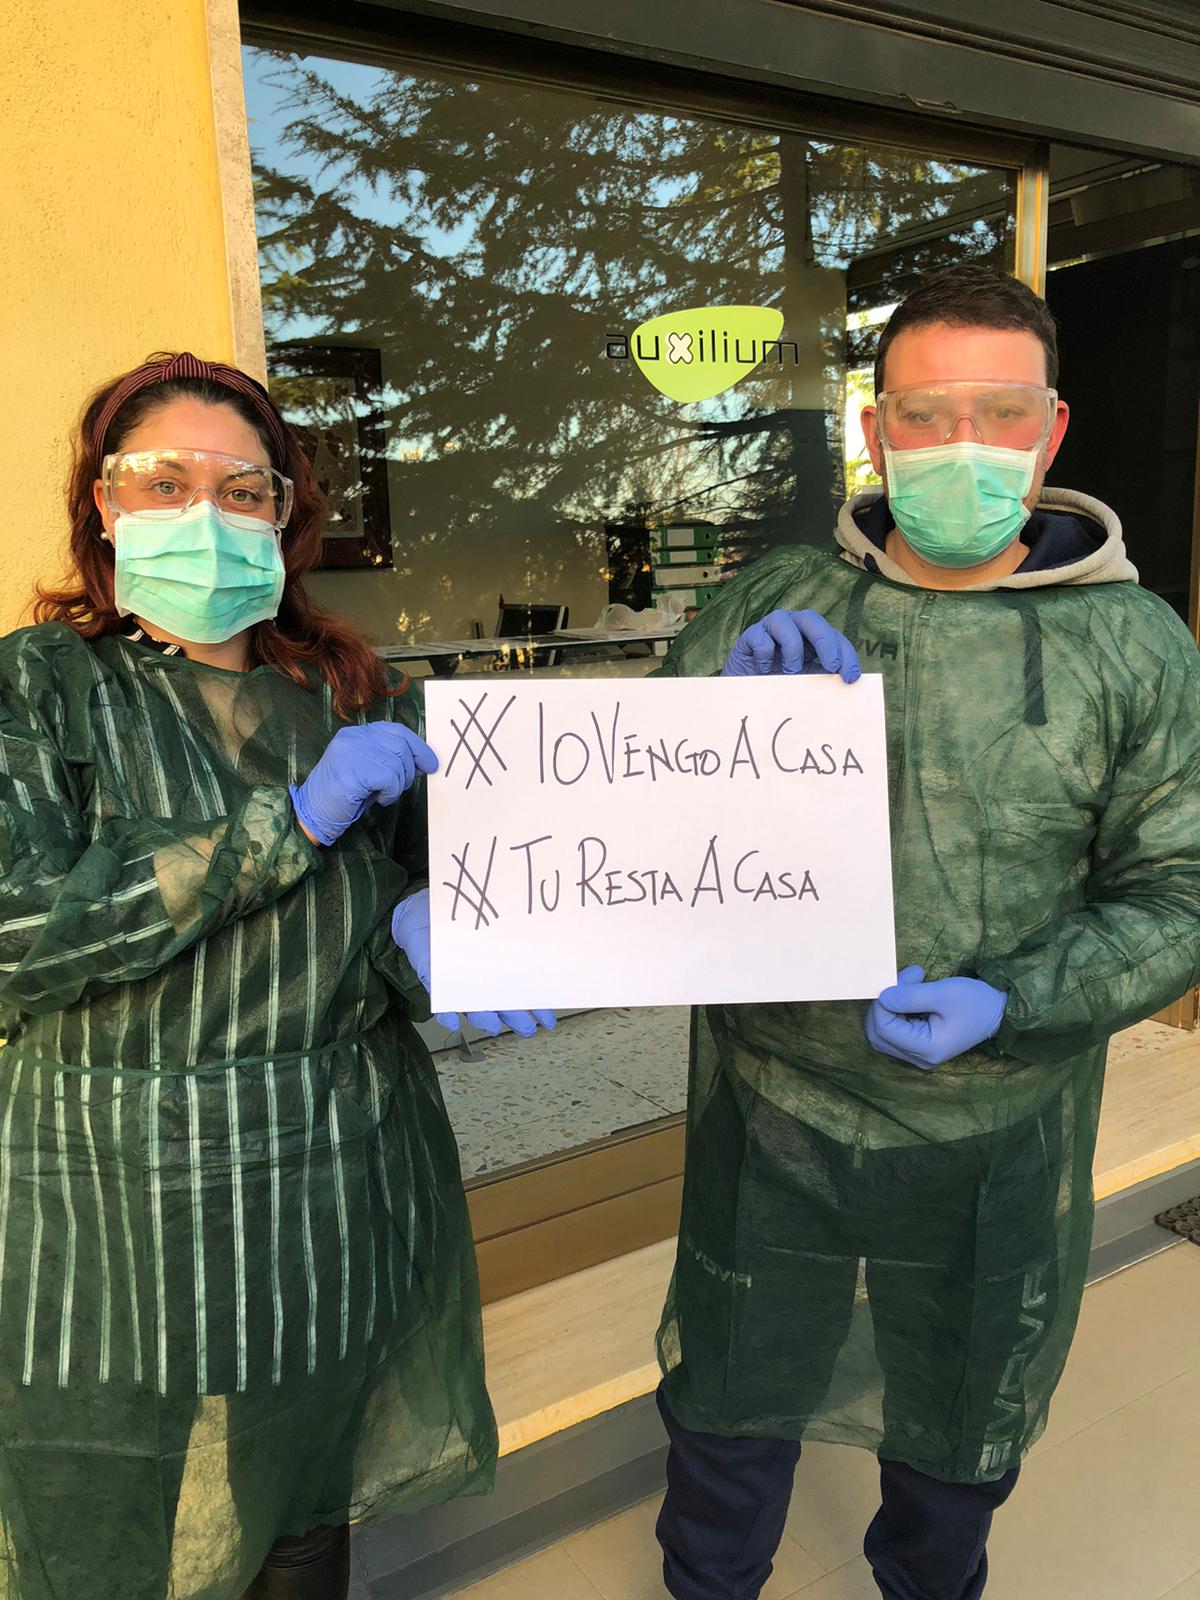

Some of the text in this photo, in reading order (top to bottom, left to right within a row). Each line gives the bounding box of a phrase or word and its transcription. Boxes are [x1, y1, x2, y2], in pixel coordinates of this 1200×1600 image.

[604, 329, 799, 365] auxilium
[730, 716, 761, 780] A
[771, 718, 864, 777] CASA
[575, 837, 684, 908] RESTA
[690, 835, 724, 908] A
[733, 850, 820, 903] CASA
